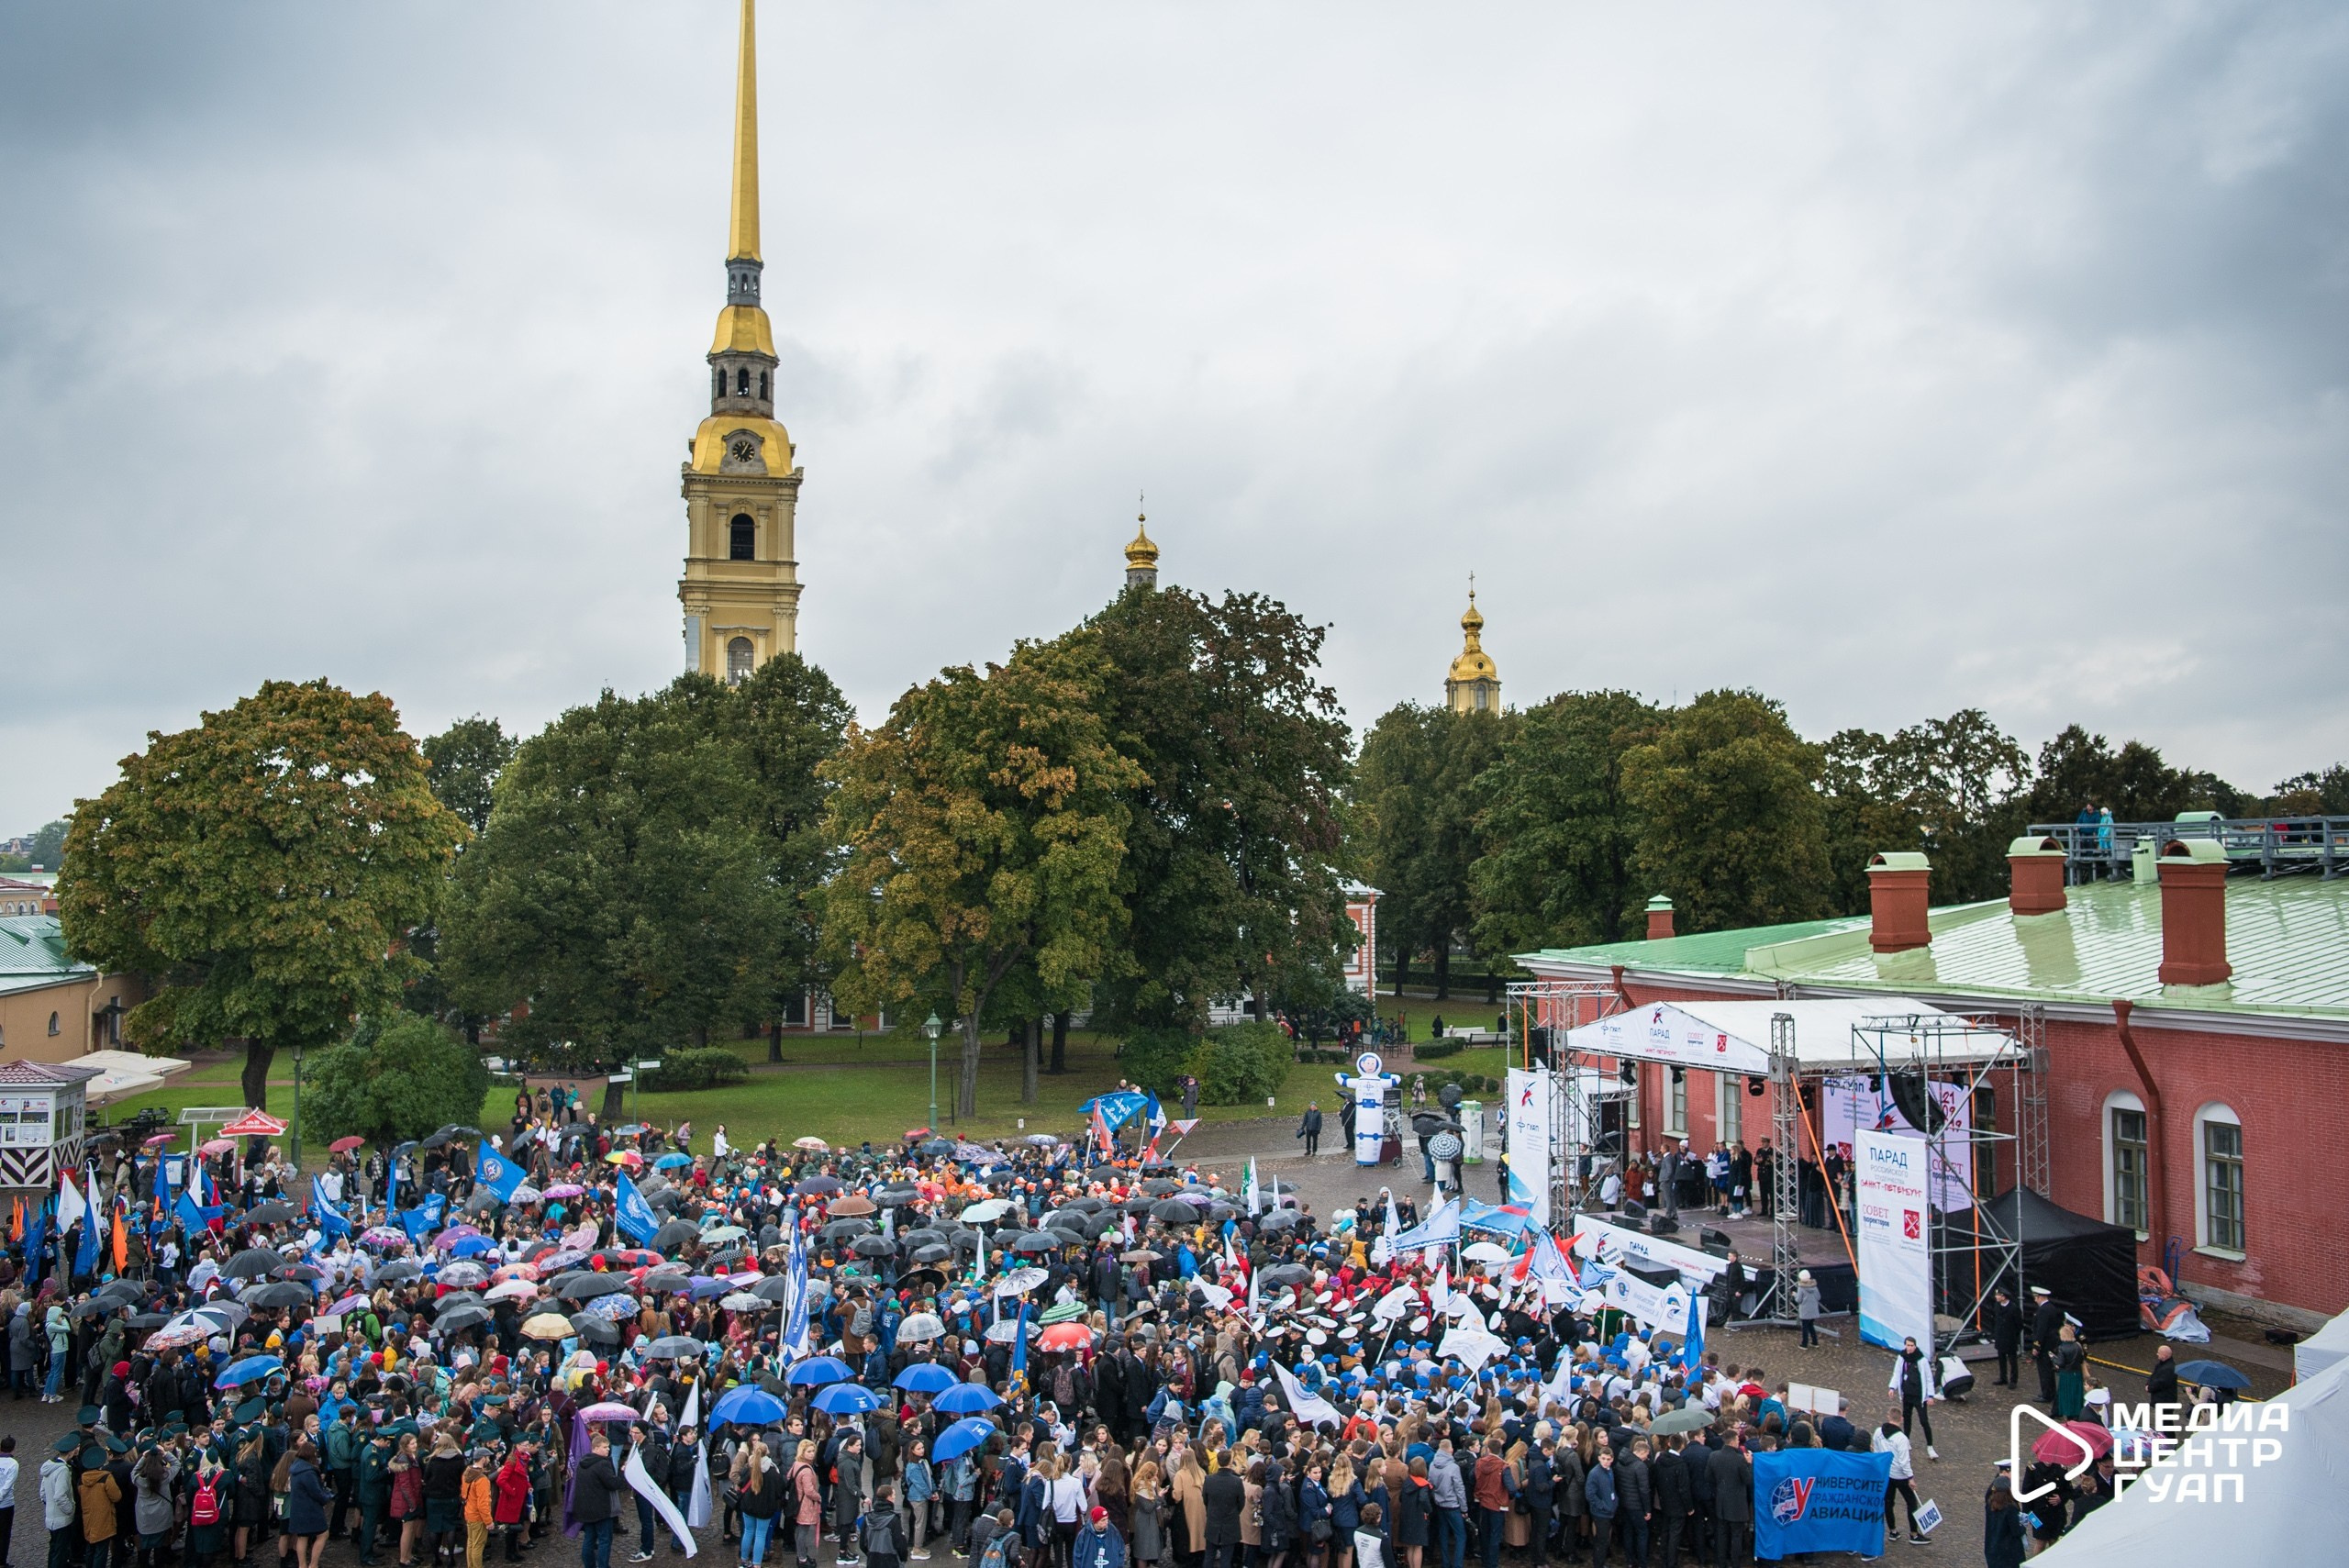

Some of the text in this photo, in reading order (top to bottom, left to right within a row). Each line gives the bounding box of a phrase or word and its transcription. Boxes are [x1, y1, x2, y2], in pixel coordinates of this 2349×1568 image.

[1649, 1028, 1670, 1040] ПАРАД
[1943, 1091, 1954, 1105] 21
[1870, 1147, 1908, 1170] ПАРАД
[1860, 1179, 1923, 1197] САНКТ-ПЕТЕРБУРГ
[1863, 1204, 1889, 1218] СОВЕТ
[1629, 1240, 1650, 1256] ПАРАД
[1809, 1507, 1885, 1523] АВИАЦИИ
